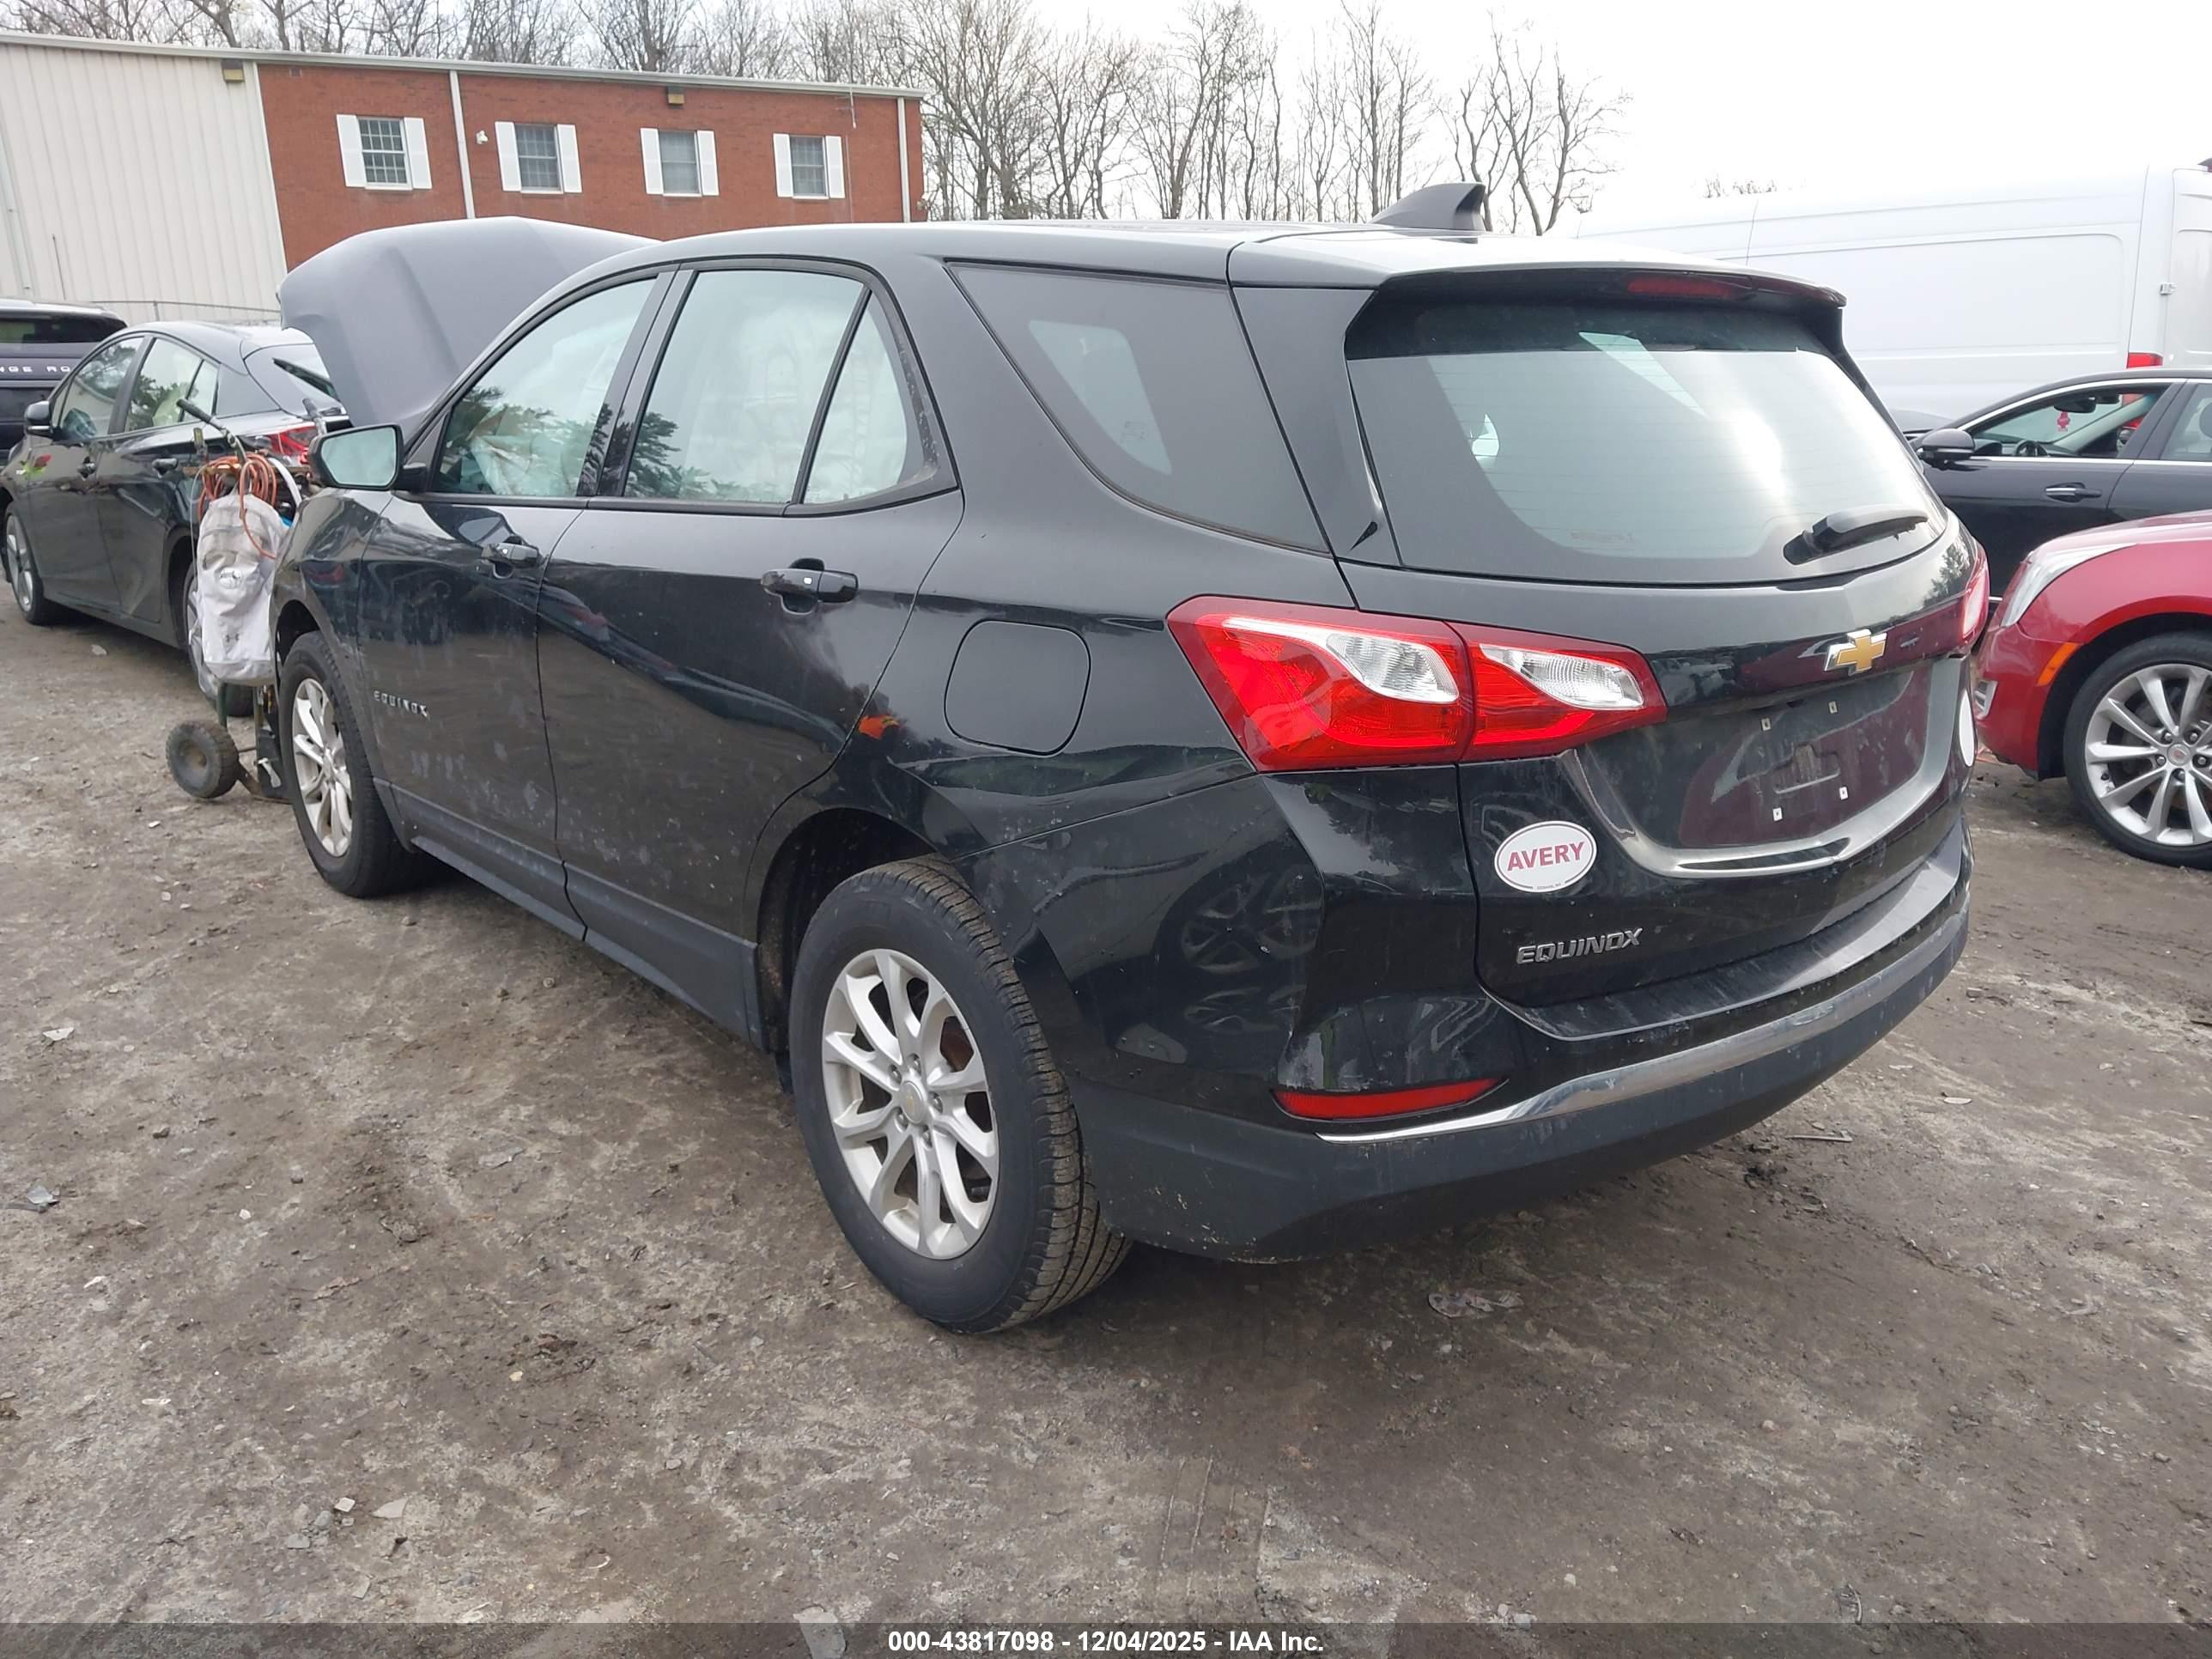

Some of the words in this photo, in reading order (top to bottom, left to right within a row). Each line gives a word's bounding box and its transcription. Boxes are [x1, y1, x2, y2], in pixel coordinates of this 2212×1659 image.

[374, 690, 428, 718] EQUINOX
[1507, 842, 1585, 872] AVERY
[1516, 927, 1644, 964] EQUINOX
